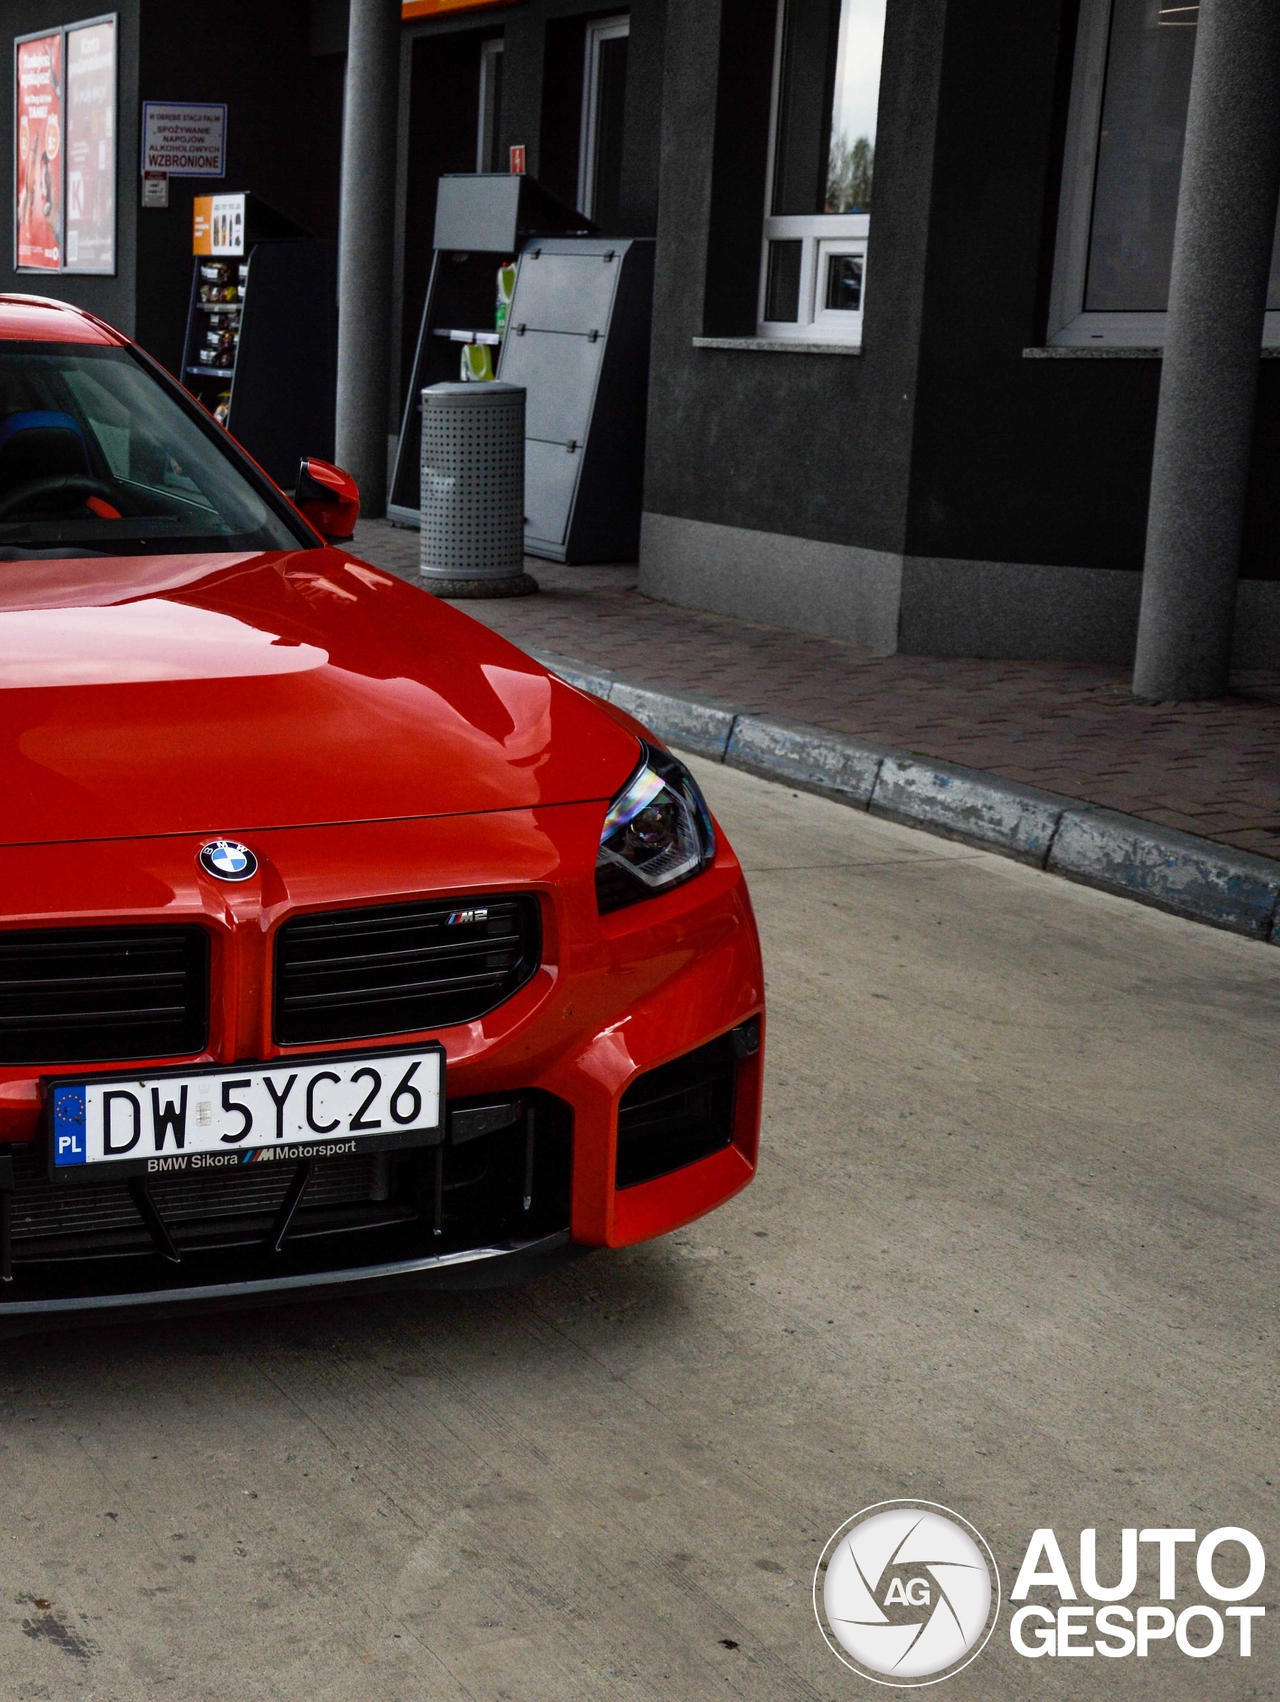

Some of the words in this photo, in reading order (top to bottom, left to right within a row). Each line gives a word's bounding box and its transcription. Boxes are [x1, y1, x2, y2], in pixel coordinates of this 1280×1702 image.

[157, 124, 211, 135] SPOŻYWANIE
[163, 134, 205, 144] NAPOJÓW
[149, 144, 220, 153] ALKOHOLOWYCH
[148, 154, 219, 169] WZBRONIONE
[102, 1084, 188, 1156] DW
[220, 1060, 423, 1145] 5YC26
[58, 1134, 82, 1155] PL
[147, 1157, 187, 1173] BMW
[191, 1152, 238, 1169] Sikora
[276, 1140, 356, 1160] Motorsport
